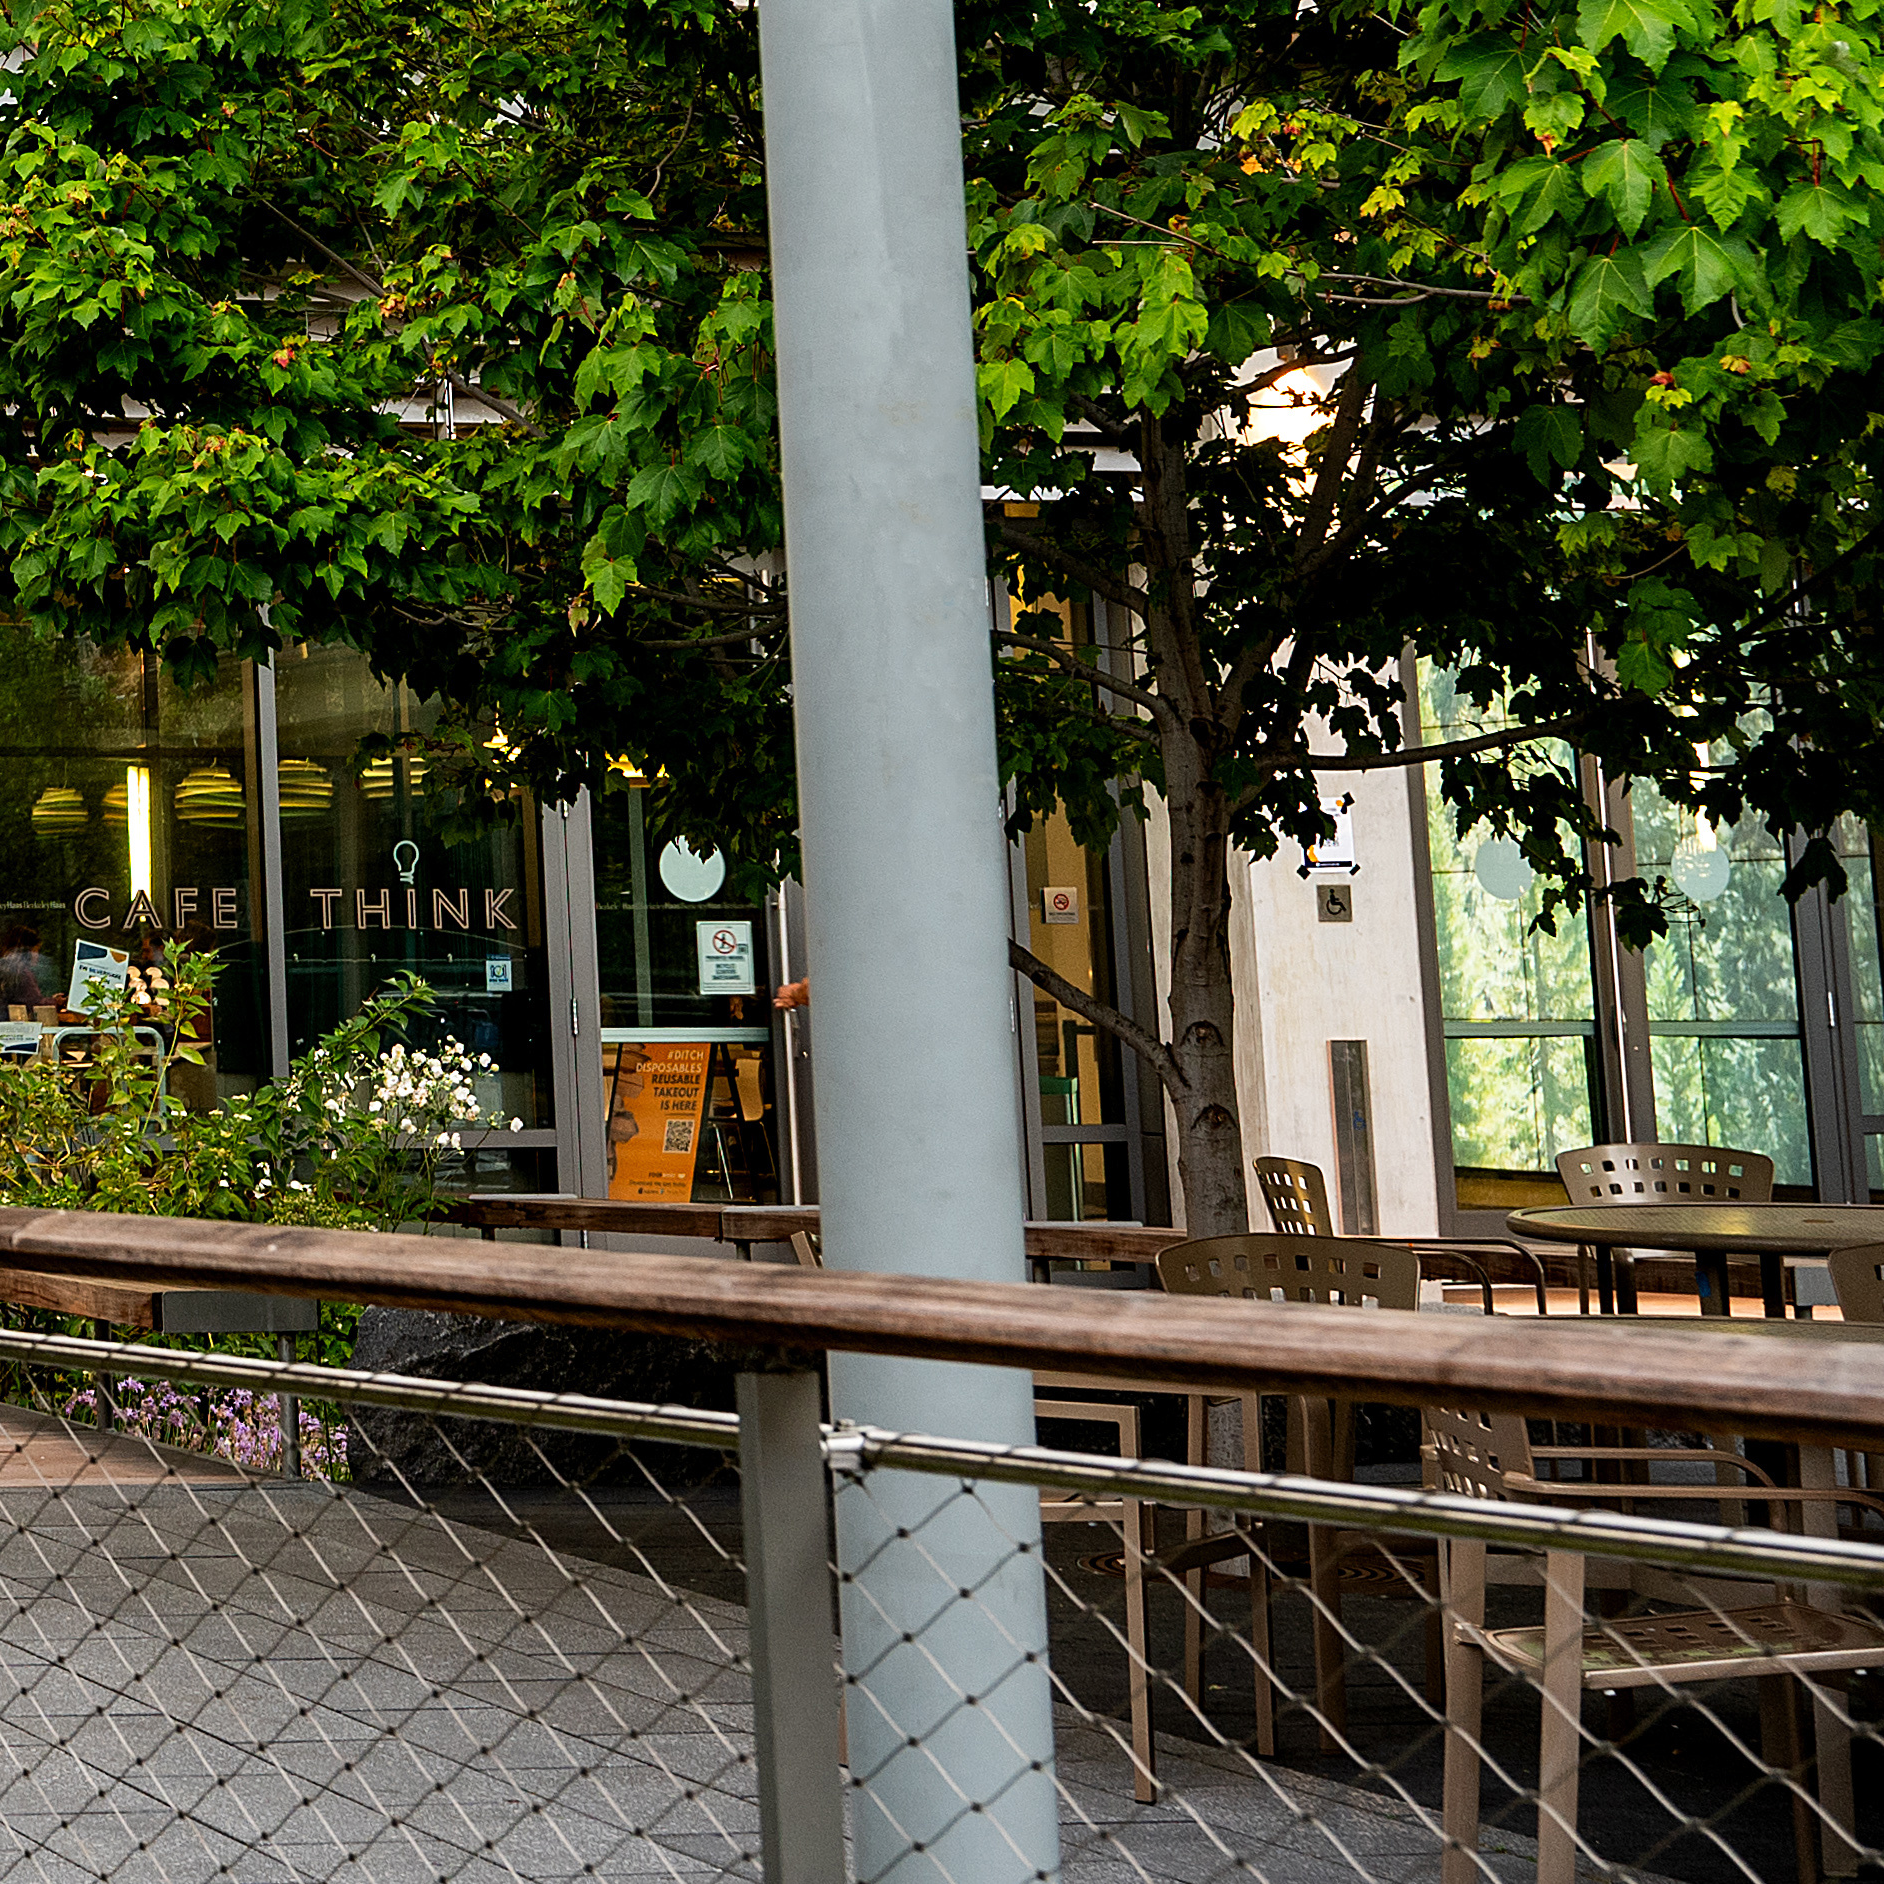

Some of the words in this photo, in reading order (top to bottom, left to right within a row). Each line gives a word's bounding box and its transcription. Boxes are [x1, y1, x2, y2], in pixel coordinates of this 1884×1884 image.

[74, 887, 238, 930] CAFE
[309, 888, 518, 930] THINK
[667, 1049, 704, 1061] #DITCH
[635, 1062, 703, 1073] DISPOSABLES
[651, 1073, 701, 1085] REUSABLE
[653, 1086, 700, 1098] TAKEOUT
[660, 1100, 669, 1110] IS
[672, 1101, 698, 1111] HERE
